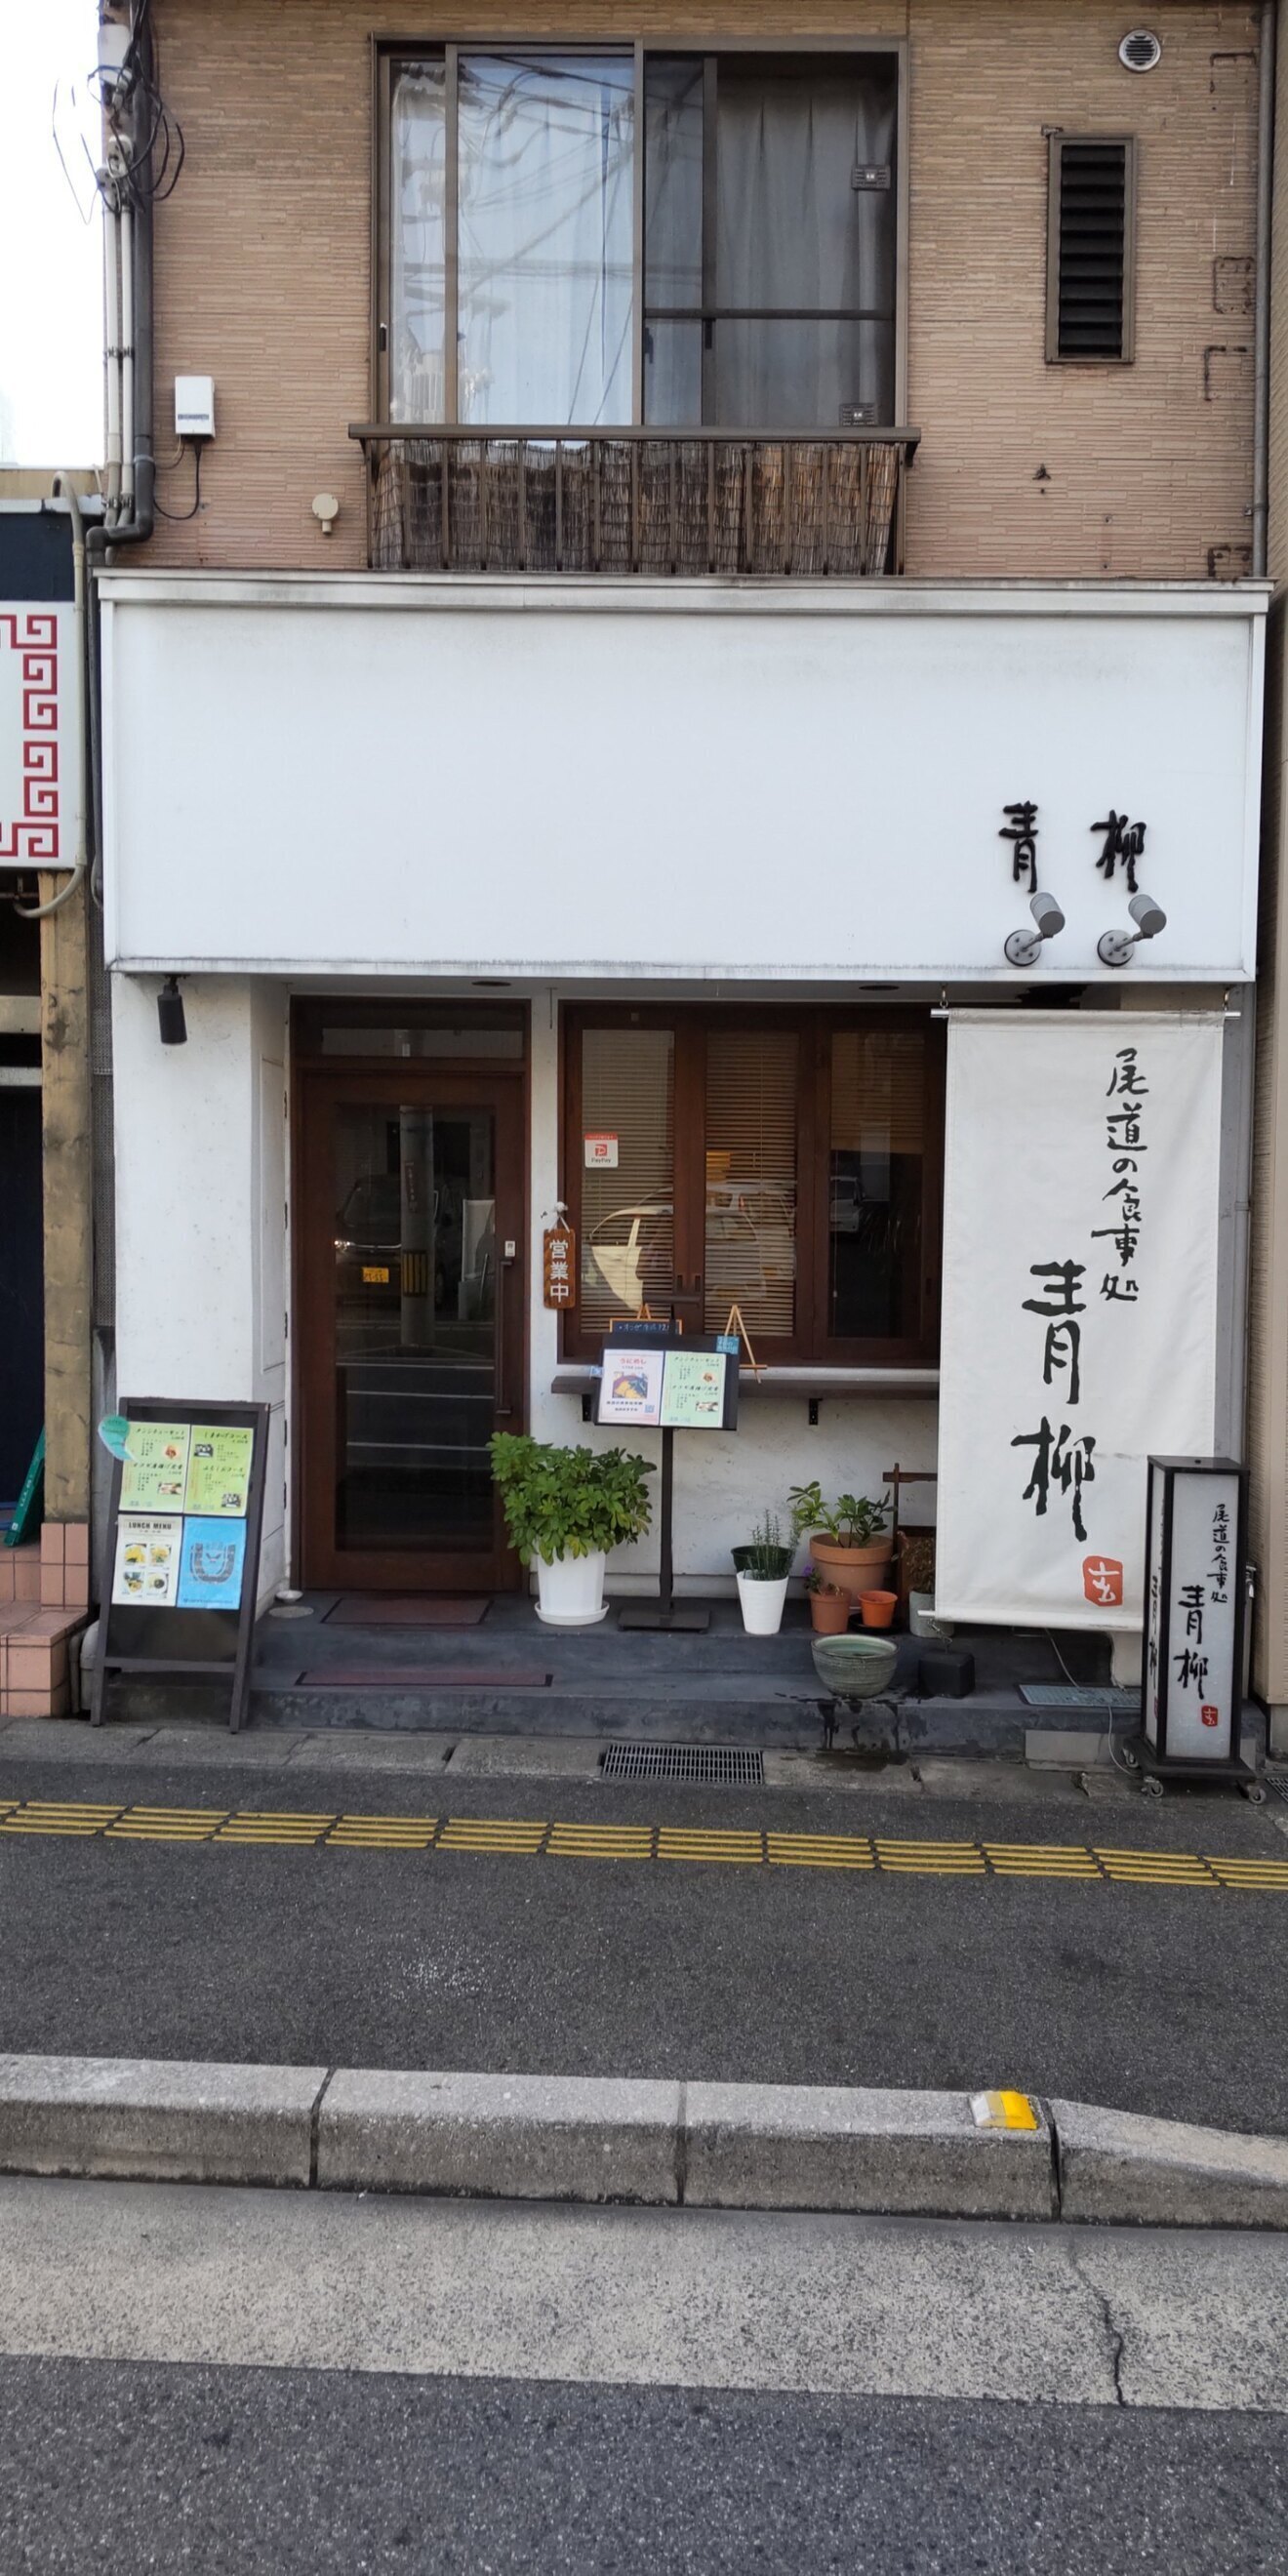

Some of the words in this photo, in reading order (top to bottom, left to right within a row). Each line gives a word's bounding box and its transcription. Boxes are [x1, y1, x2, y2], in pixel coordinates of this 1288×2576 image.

[998, 800, 1147, 894] 青柳
[1091, 1048, 1149, 1302] 尾道の食事処
[549, 1239, 569, 1303] 営業中
[1011, 1259, 1096, 1542] 青柳
[1207, 1503, 1229, 1603] 尾道の食事処
[1173, 1585, 1210, 1700] 青柳
